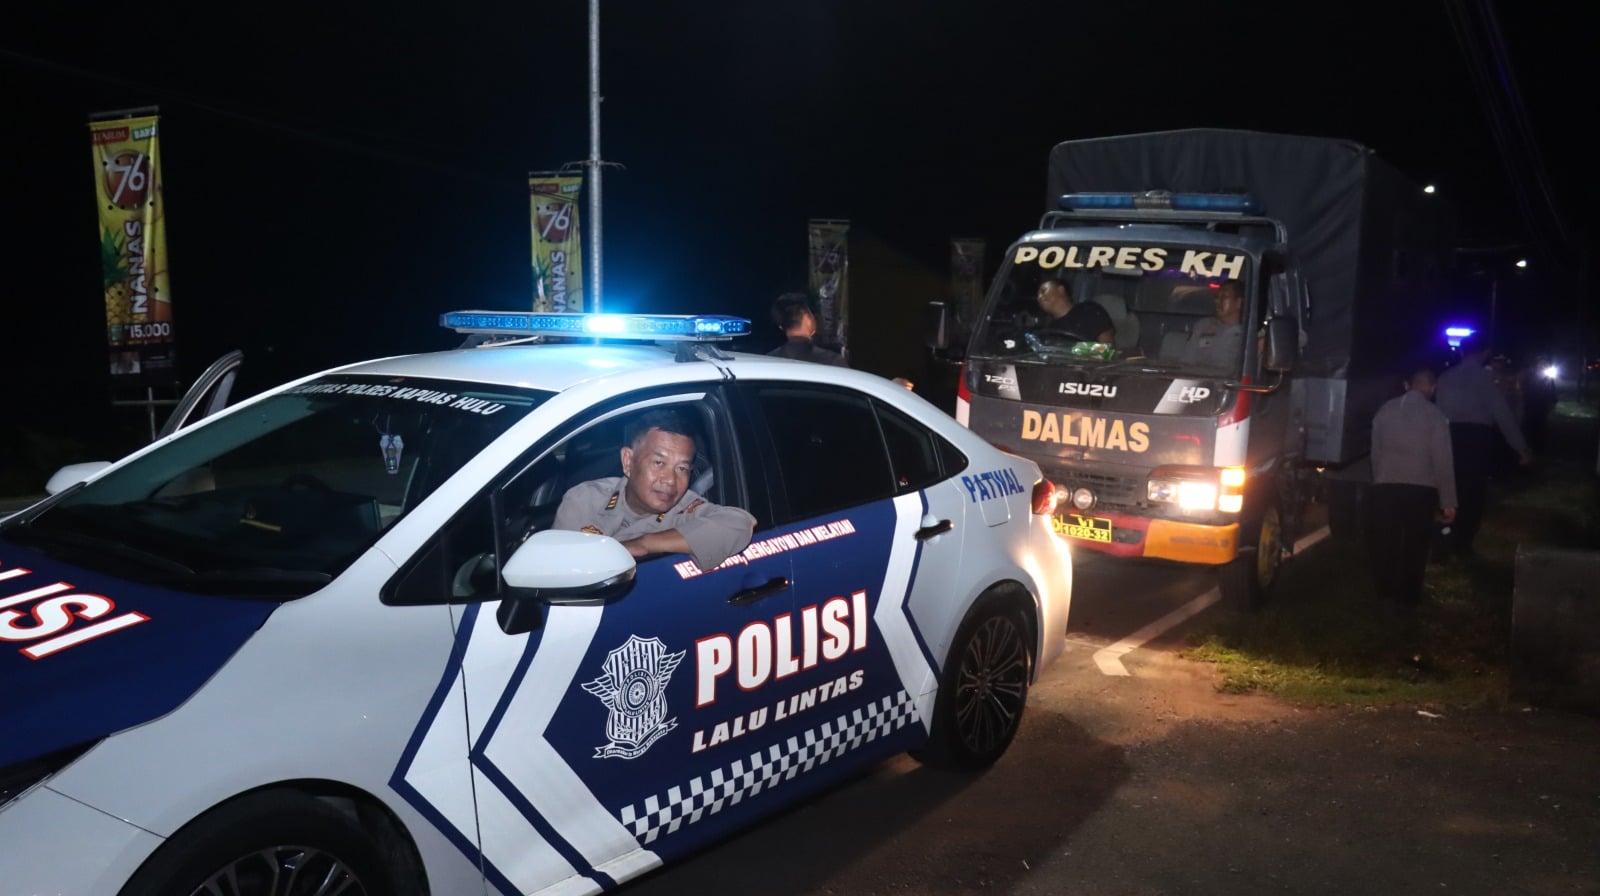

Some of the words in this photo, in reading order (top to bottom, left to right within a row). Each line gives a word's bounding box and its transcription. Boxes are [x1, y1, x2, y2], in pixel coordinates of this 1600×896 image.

[108, 153, 146, 204] 76
[543, 202, 570, 238] 76
[125, 219, 148, 315] NANAS
[1014, 245, 1168, 271] POLRES
[1179, 249, 1245, 280] KH
[130, 322, 170, 338] 15.000
[984, 374, 1015, 385] 120
[1058, 382, 1118, 398] ISUZU
[337, 384, 398, 397] POLRES
[388, 387, 458, 405] KAPUAS
[449, 396, 506, 415] HULU
[1021, 410, 1151, 453] DALMAS
[961, 467, 1025, 503] PATWAL
[742, 532, 800, 561] MENGAYOMI
[793, 528, 818, 547] DAN
[811, 518, 856, 542] MELAYANI
[1062, 525, 1109, 541] 1020-32
[694, 588, 868, 709] POLISI
[691, 706, 769, 754] LALU
[774, 669, 865, 722] LINTAS
